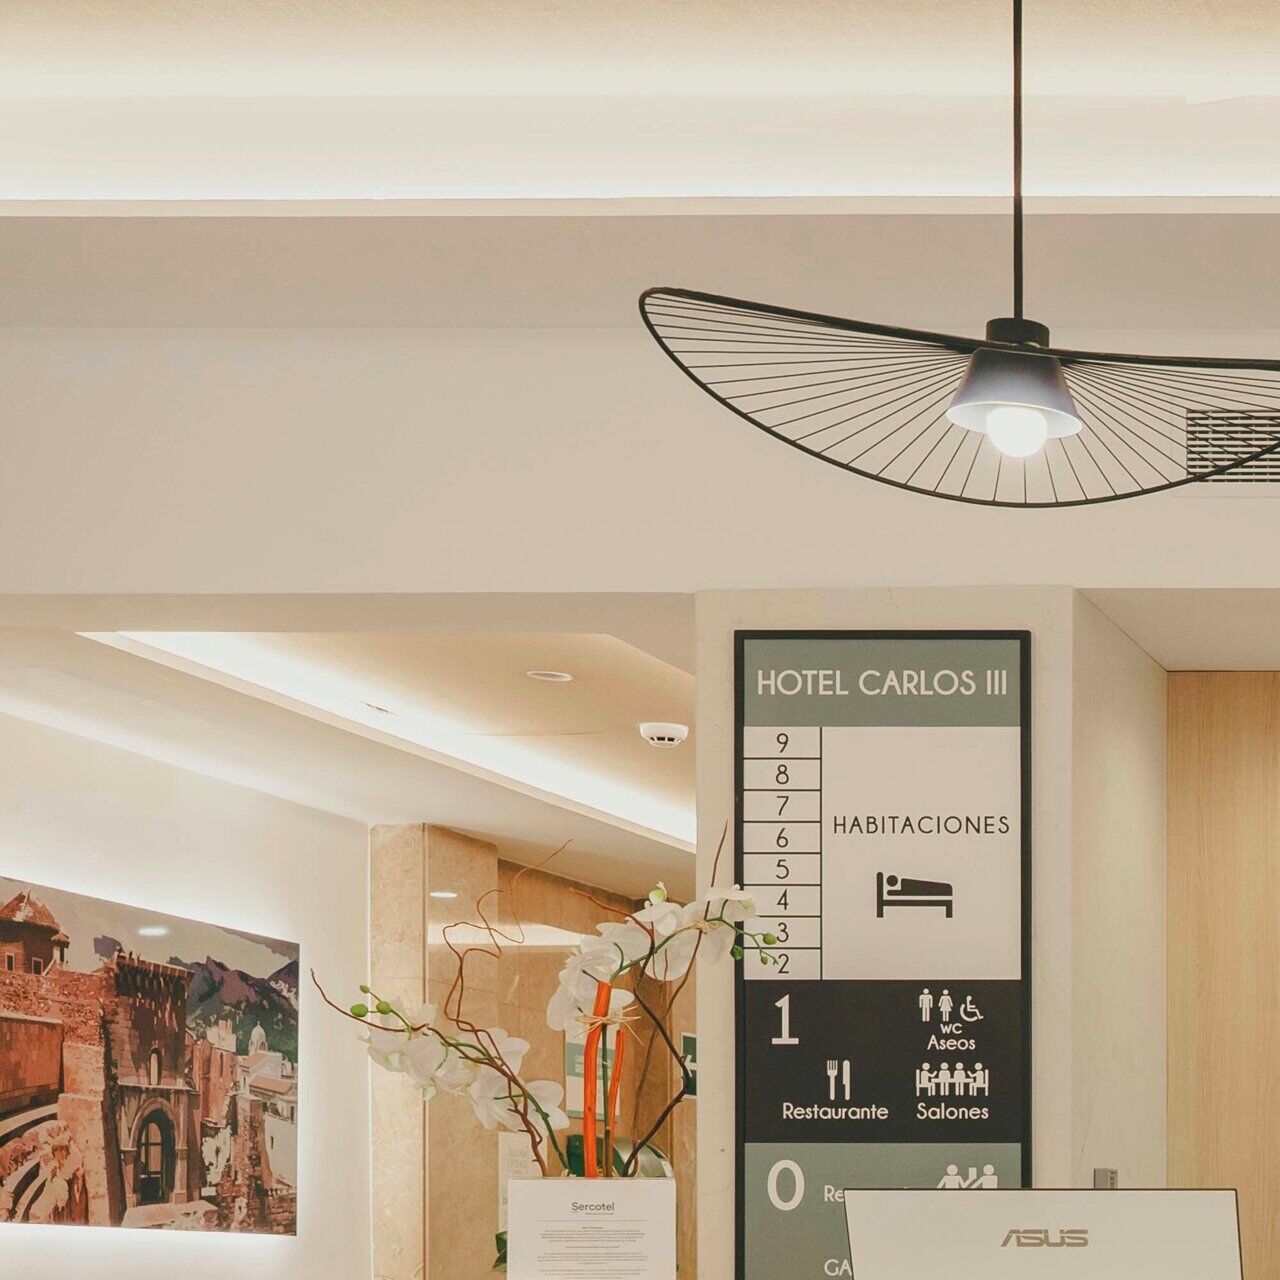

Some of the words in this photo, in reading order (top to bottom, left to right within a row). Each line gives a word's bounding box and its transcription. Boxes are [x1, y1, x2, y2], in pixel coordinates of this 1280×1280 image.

[757, 669, 849, 696] HOTEL
[858, 669, 977, 696] CARLOS
[986, 669, 1007, 695] III
[776, 732, 789, 754] 9
[775, 764, 790, 785] 8
[776, 795, 790, 816] 7
[833, 815, 1010, 835] HABITACIONES
[776, 827, 789, 849] 6
[776, 859, 790, 880] 5
[776, 888, 790, 910] 4
[776, 921, 789, 943] 3
[778, 953, 790, 974] 2
[771, 993, 800, 1045] 1
[926, 1034, 977, 1051] Aseos
[782, 1102, 890, 1120] Restaurante
[916, 1102, 990, 1120] Salones
[767, 1159, 805, 1211] 0
[571, 1201, 616, 1213] Sercotel
[1000, 1228, 1089, 1248] ASUS
